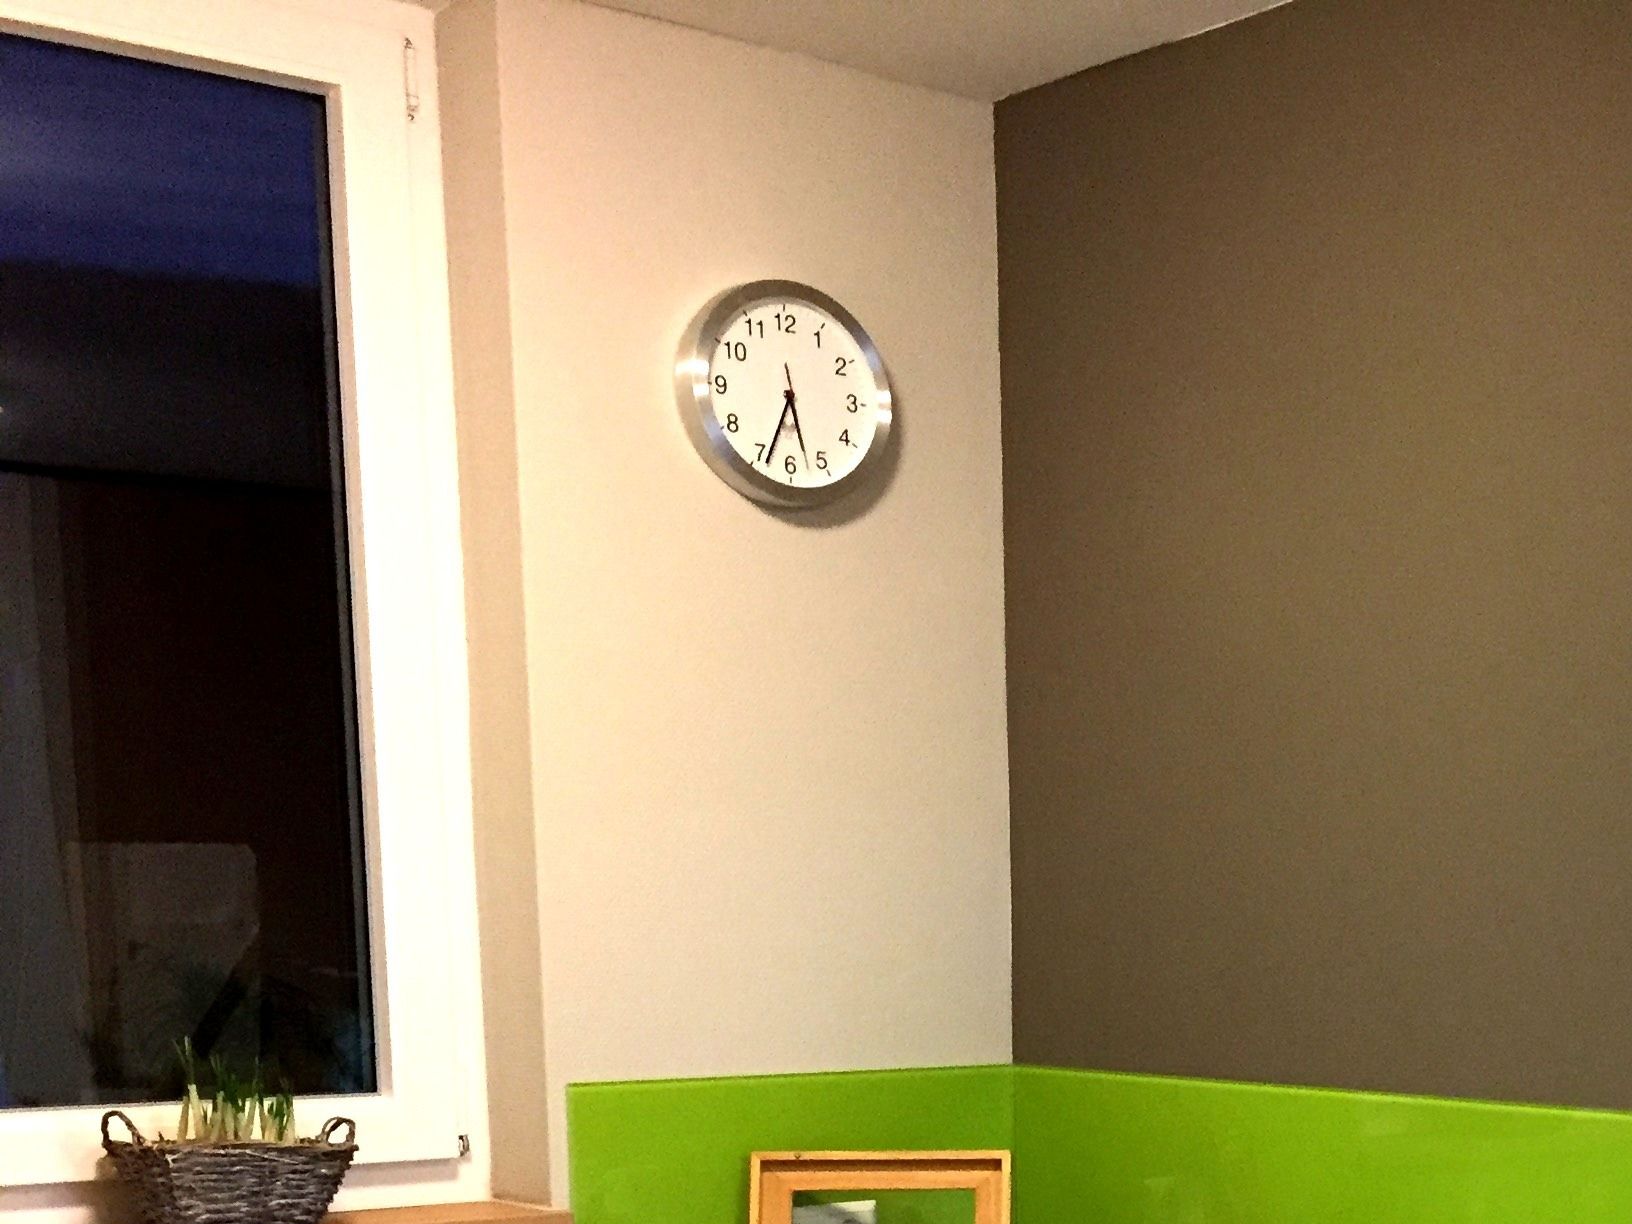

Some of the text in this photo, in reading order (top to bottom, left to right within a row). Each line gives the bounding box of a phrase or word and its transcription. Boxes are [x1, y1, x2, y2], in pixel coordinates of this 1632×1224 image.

[745, 318, 764, 339] 11
[774, 313, 796, 334] 12
[813, 330, 822, 349] 1
[723, 341, 747, 362] 10
[835, 356, 847, 377] 2
[714, 374, 728, 395] 9
[846, 394, 858, 413] 3
[726, 413, 739, 433] 8
[838, 429, 851, 446] 4
[754, 443, 766, 461] 7
[816, 451, 828, 470] 5
[784, 455, 797, 475] 6
